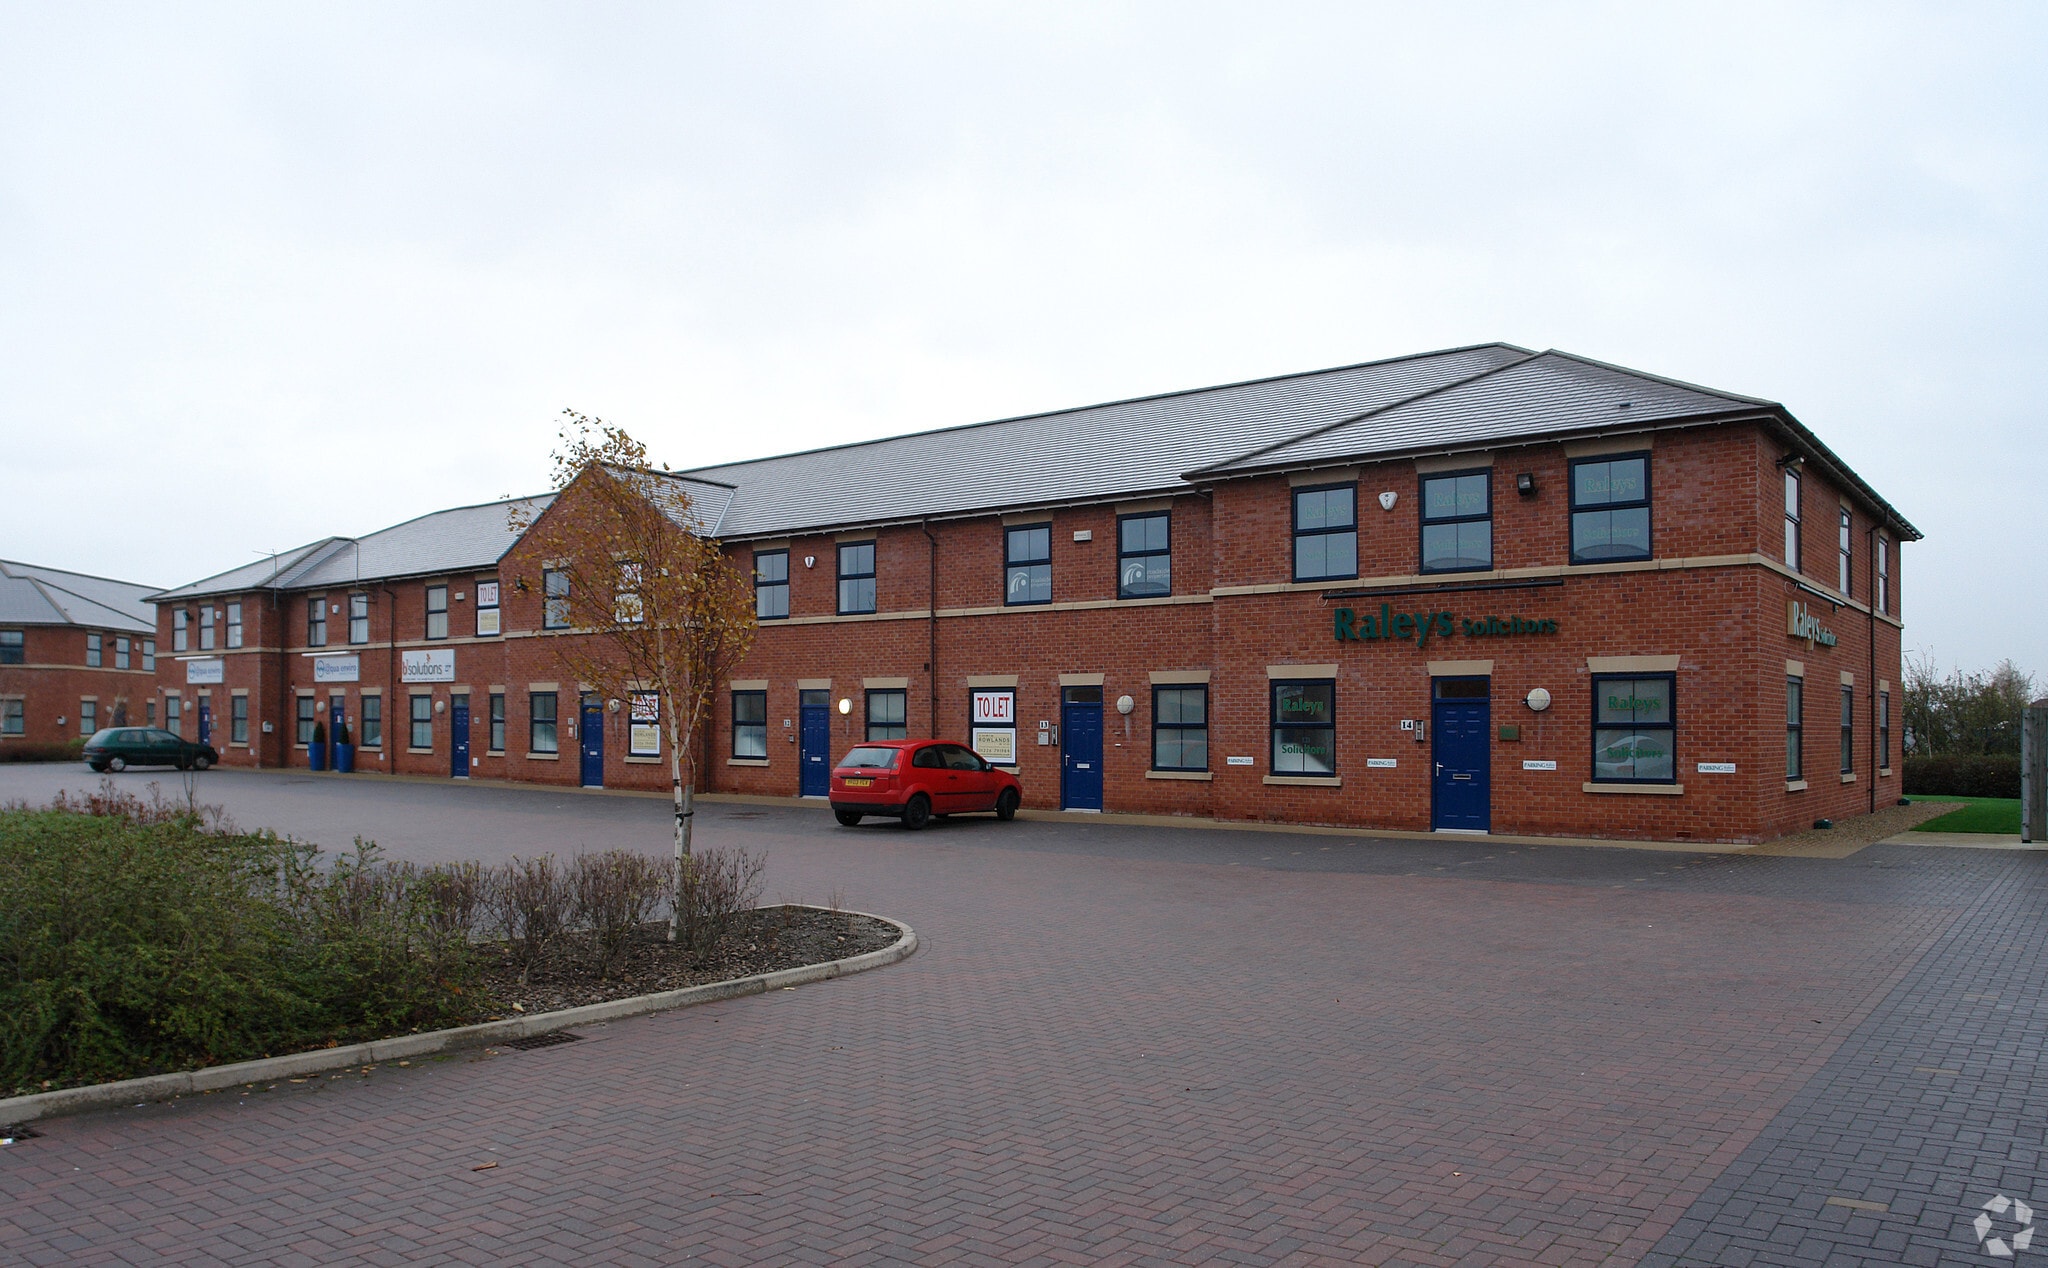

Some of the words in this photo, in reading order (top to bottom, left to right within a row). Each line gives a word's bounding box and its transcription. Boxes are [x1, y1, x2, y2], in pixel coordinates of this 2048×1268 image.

[480, 587, 487, 602] TO
[488, 586, 497, 602] LET
[1334, 604, 1453, 648] Raleys
[1462, 614, 1559, 637] Solicitors
[1792, 600, 1820, 651] Raleys
[340, 663, 356, 672] enviro
[977, 697, 990, 717] TO
[993, 697, 1010, 717] LET
[1283, 698, 1324, 715] Raleys
[1608, 695, 1661, 715] Raleys
[1402, 721, 1412, 729] 14
[1281, 744, 1326, 755] Solicitors
[1606, 747, 1664, 759] Solicitors
